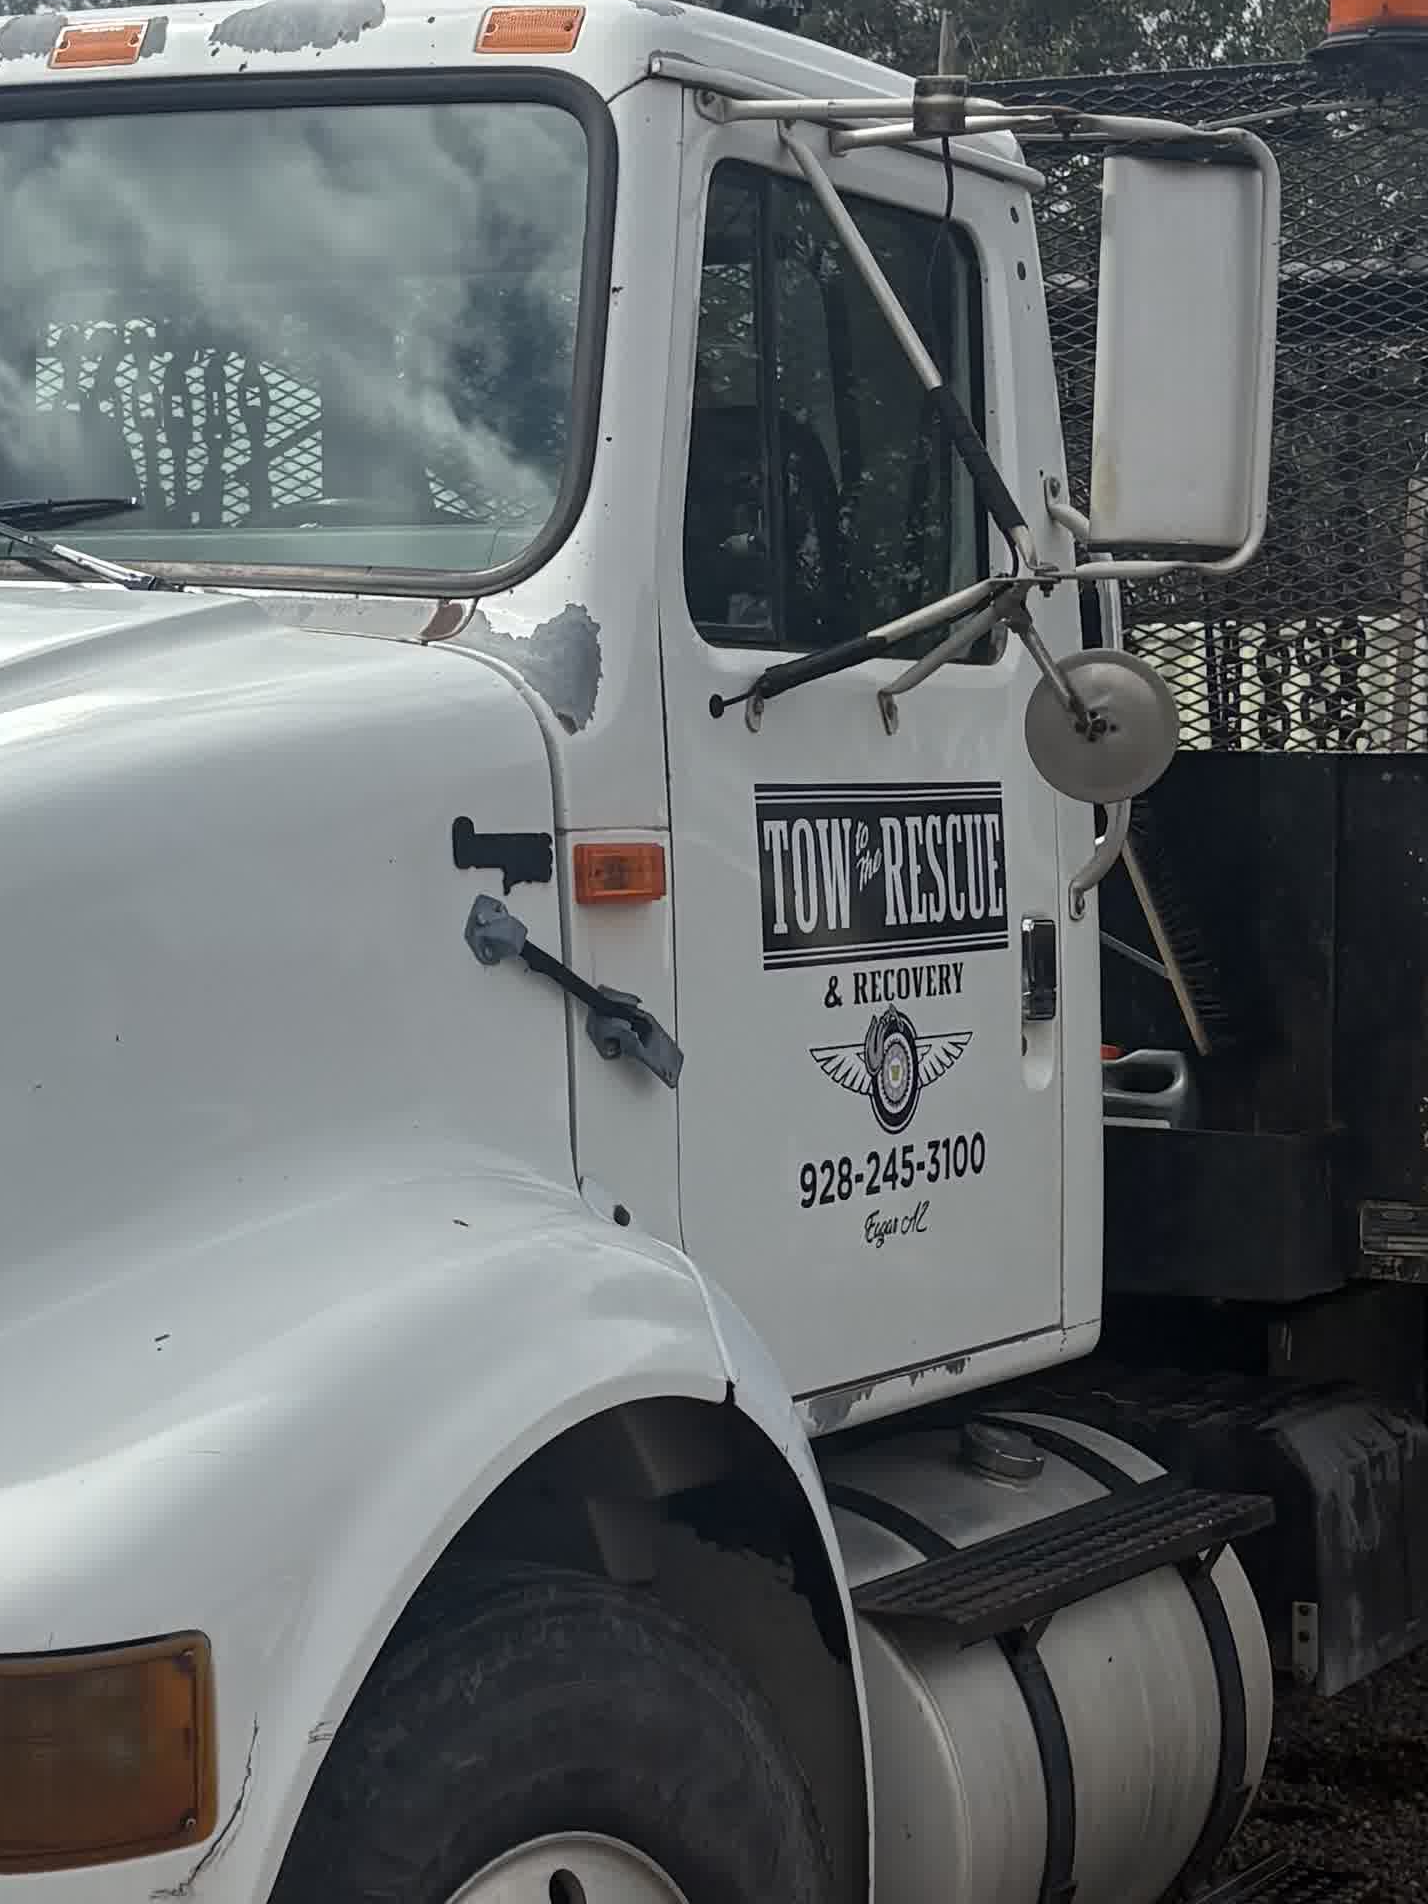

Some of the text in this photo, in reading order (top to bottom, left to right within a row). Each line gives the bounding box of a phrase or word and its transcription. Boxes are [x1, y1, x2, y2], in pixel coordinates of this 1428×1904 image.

[763, 813, 1004, 934] TOW to the RESCUE
[824, 962, 964, 1008] & RECOVERY
[800, 1131, 985, 1208] 928-245-3100
